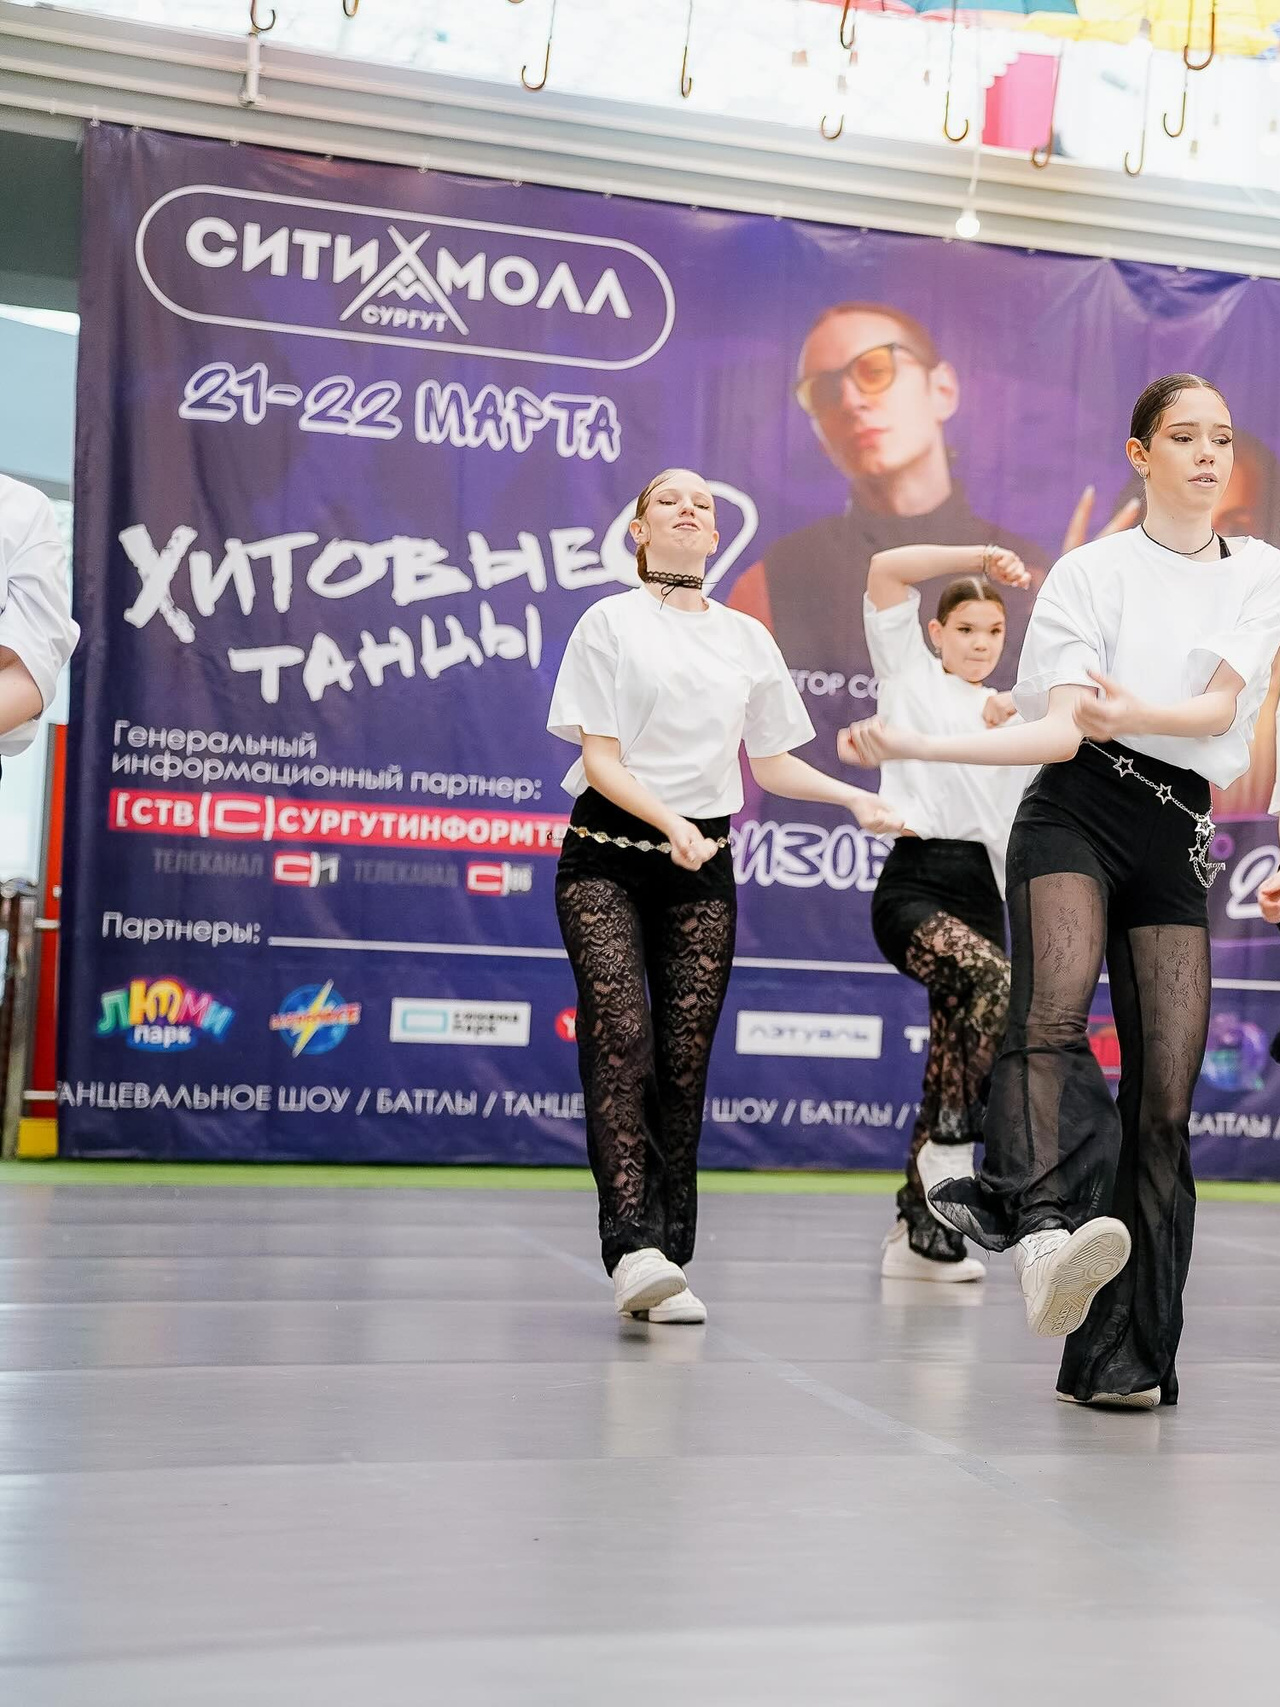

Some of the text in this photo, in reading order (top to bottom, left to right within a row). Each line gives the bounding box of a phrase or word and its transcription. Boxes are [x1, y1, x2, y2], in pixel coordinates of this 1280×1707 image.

[436, 246, 632, 319] МОЛЛ
[360, 303, 448, 333] СУРГУТ
[179, 362, 622, 463] 21-22 МАРТА
[118, 523, 601, 644] ХИТОВЫЕ
[227, 600, 544, 704] ТАНЦЫ
[113, 720, 318, 759] Генеральный
[111, 749, 543, 804] информационный партнер:
[730, 819, 896, 893] ИЗОВ
[102, 910, 262, 948] Партнеры:
[133, 1023, 193, 1049] парк
[278, 1085, 351, 1114] ШОУ
[376, 1087, 478, 1116] БАТТЛЫ
[711, 1097, 779, 1125] ШОУ
[800, 1099, 894, 1128] БАТТЛЫ
